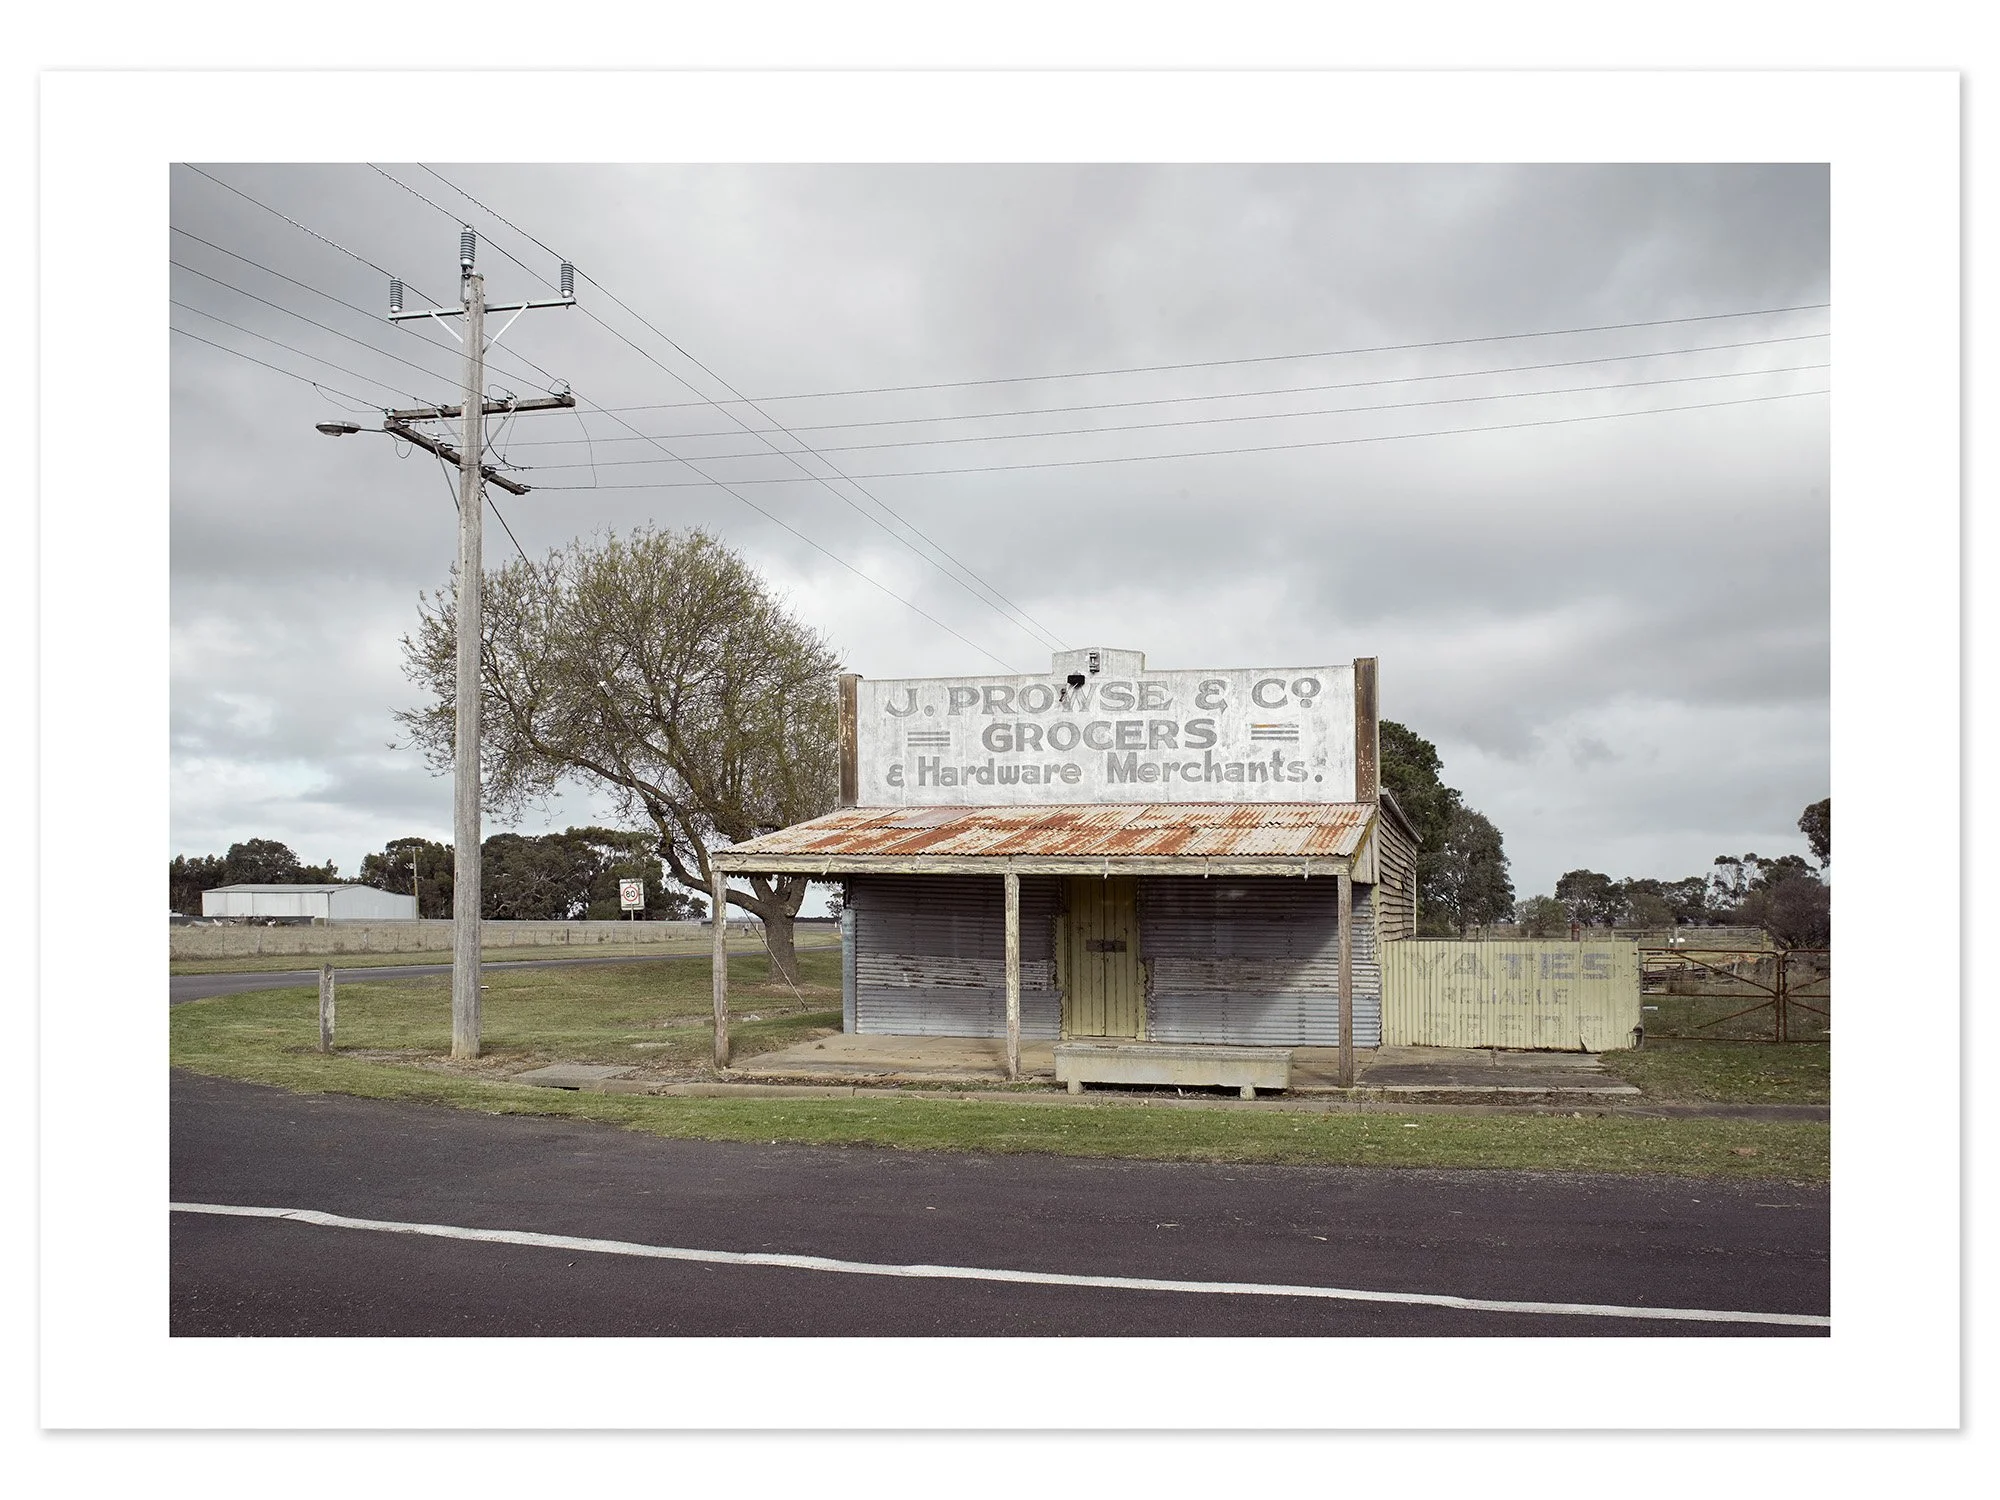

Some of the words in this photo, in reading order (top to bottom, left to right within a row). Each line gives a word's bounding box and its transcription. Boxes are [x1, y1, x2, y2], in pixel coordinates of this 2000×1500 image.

[886, 687, 935, 717] J.
[947, 679, 1174, 717] PROWSE
[1196, 679, 1227, 715] &
[982, 719, 1217, 752] GROCERS
[886, 763, 905, 787] &
[918, 756, 1082, 787] Hardware
[1107, 751, 1323, 784] Merchants.
[625, 890, 636, 898] 80
[1406, 952, 1615, 980] YATES
[1442, 987, 1568, 1006] RELIABLE
